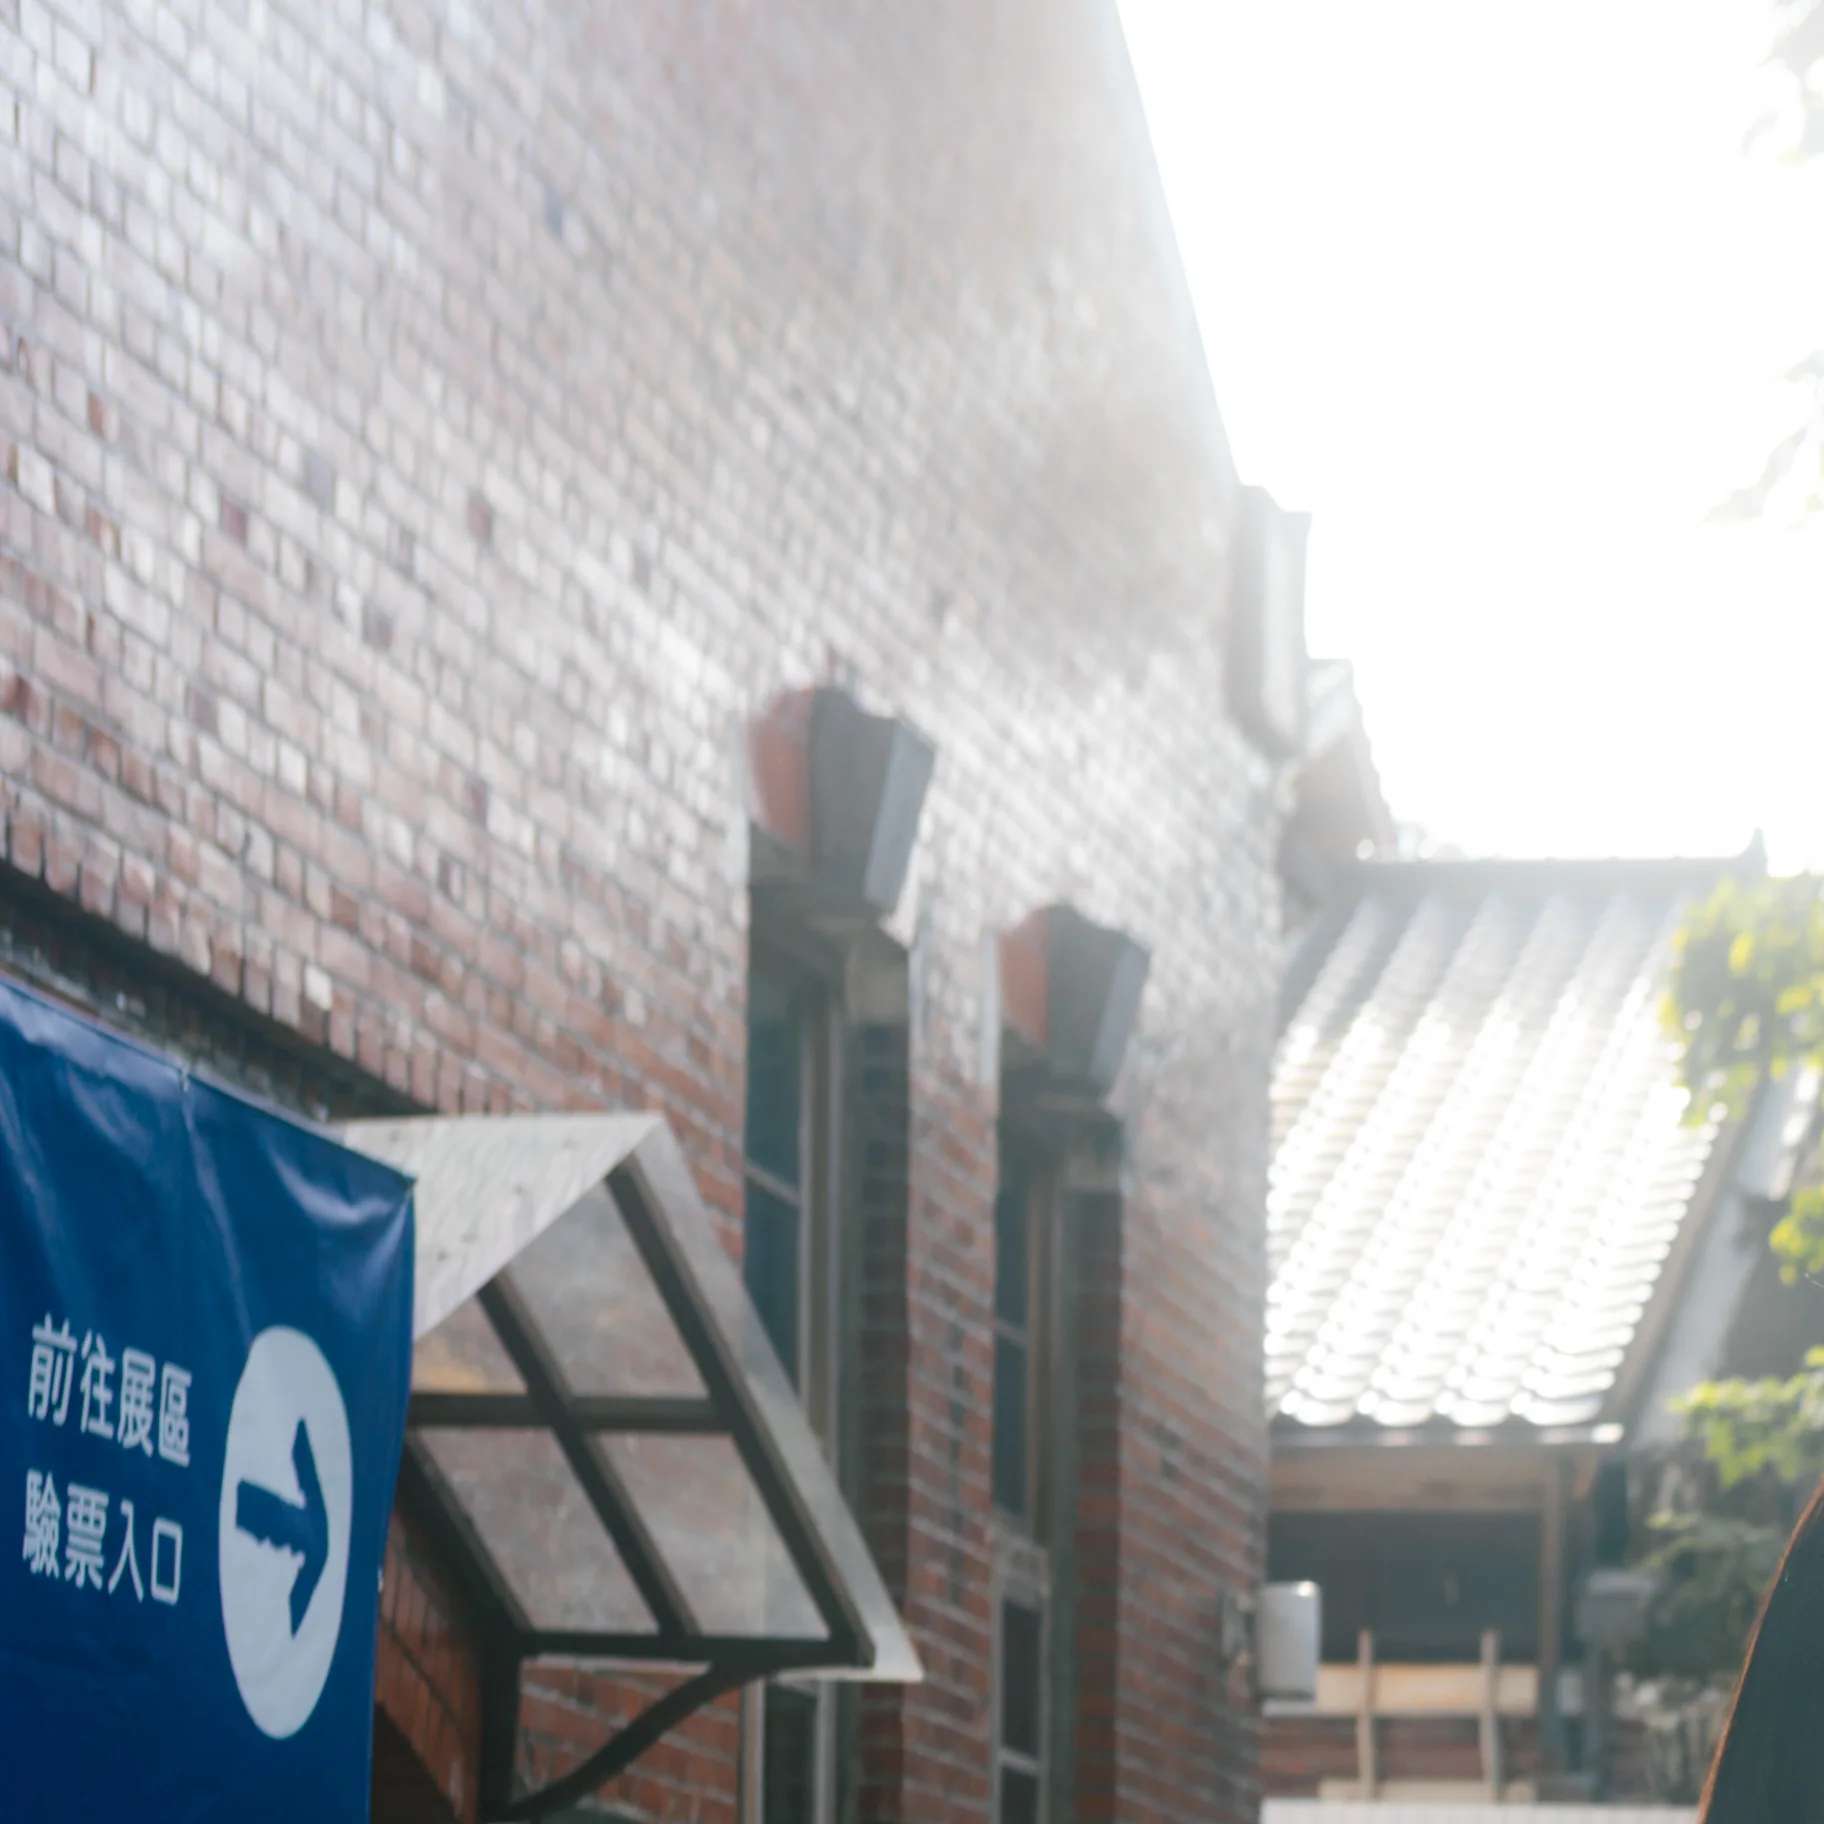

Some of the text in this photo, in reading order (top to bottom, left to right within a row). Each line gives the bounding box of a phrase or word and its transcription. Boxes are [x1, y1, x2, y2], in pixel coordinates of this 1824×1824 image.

[27, 1312, 193, 1468] 前往展區
[22, 1468, 184, 1607] 驗票入口
